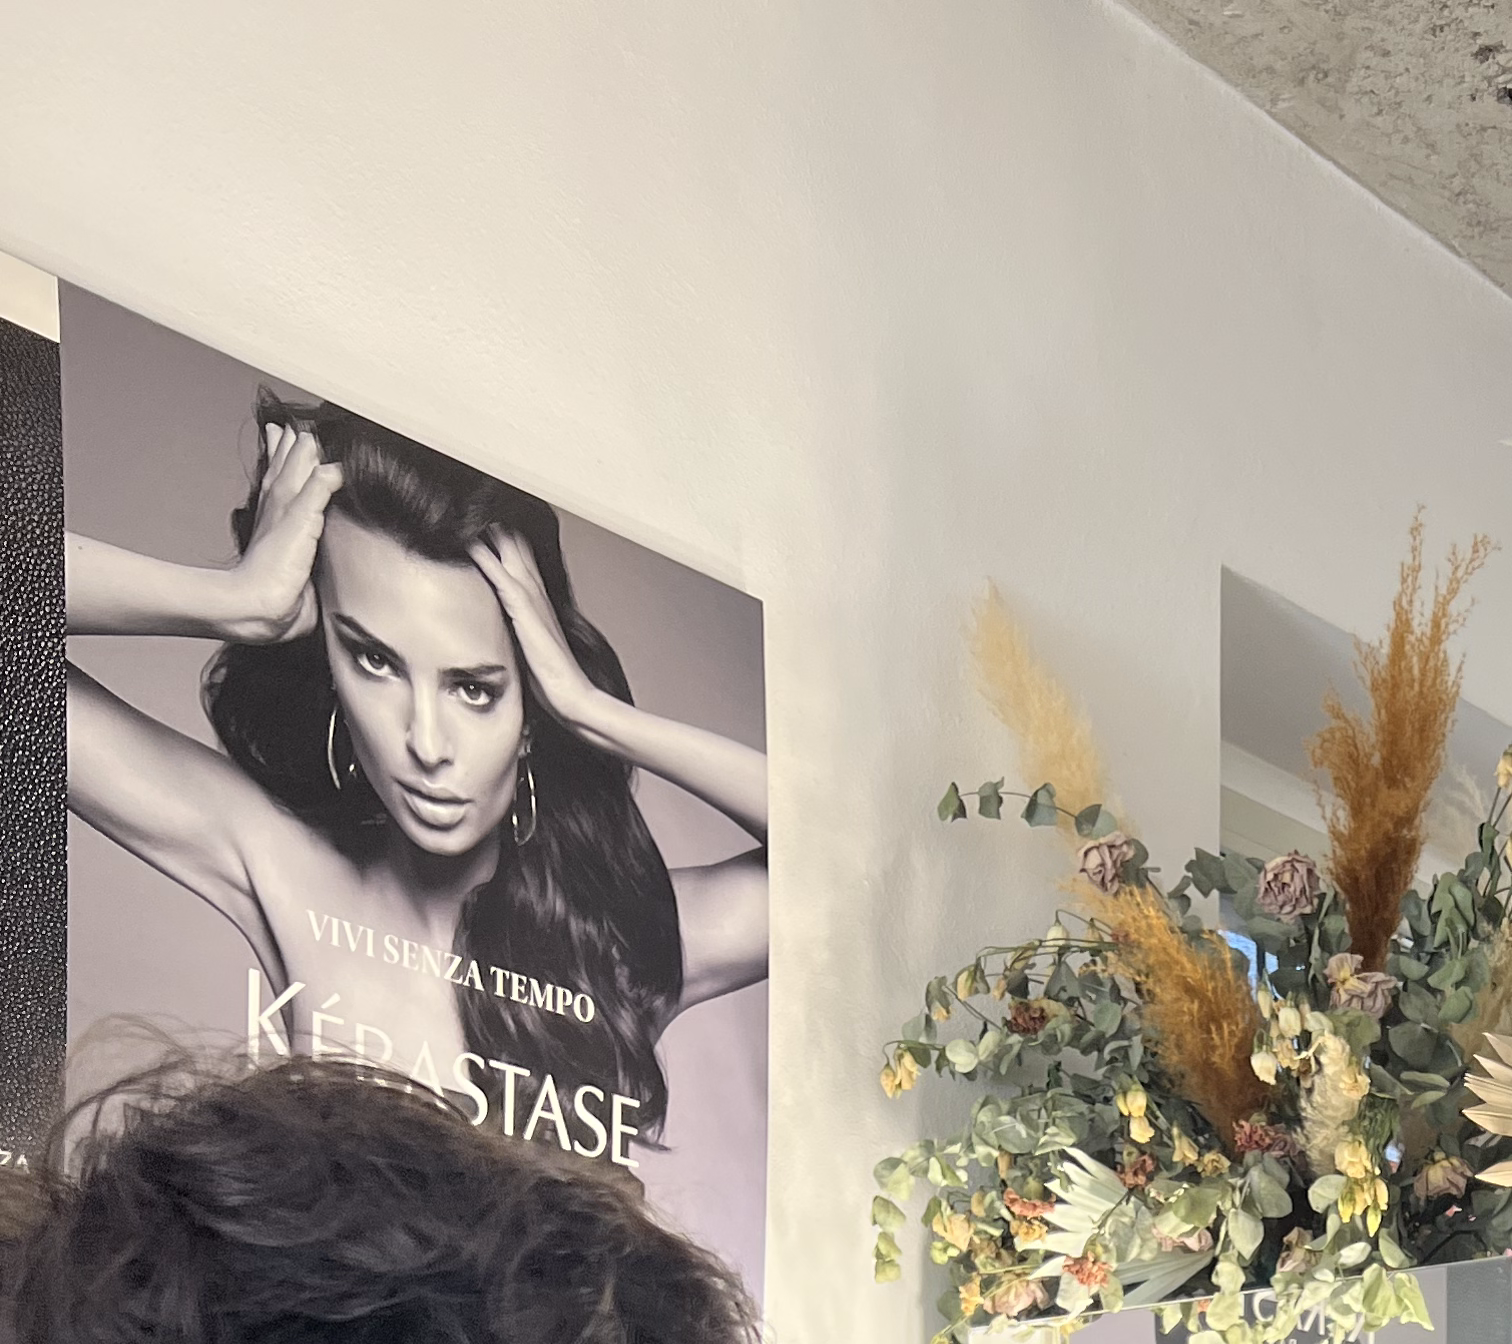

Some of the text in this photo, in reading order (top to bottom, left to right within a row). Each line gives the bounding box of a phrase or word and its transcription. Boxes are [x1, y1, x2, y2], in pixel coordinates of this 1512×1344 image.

[307, 909, 595, 1023] VIVI SENZA TEMPO
